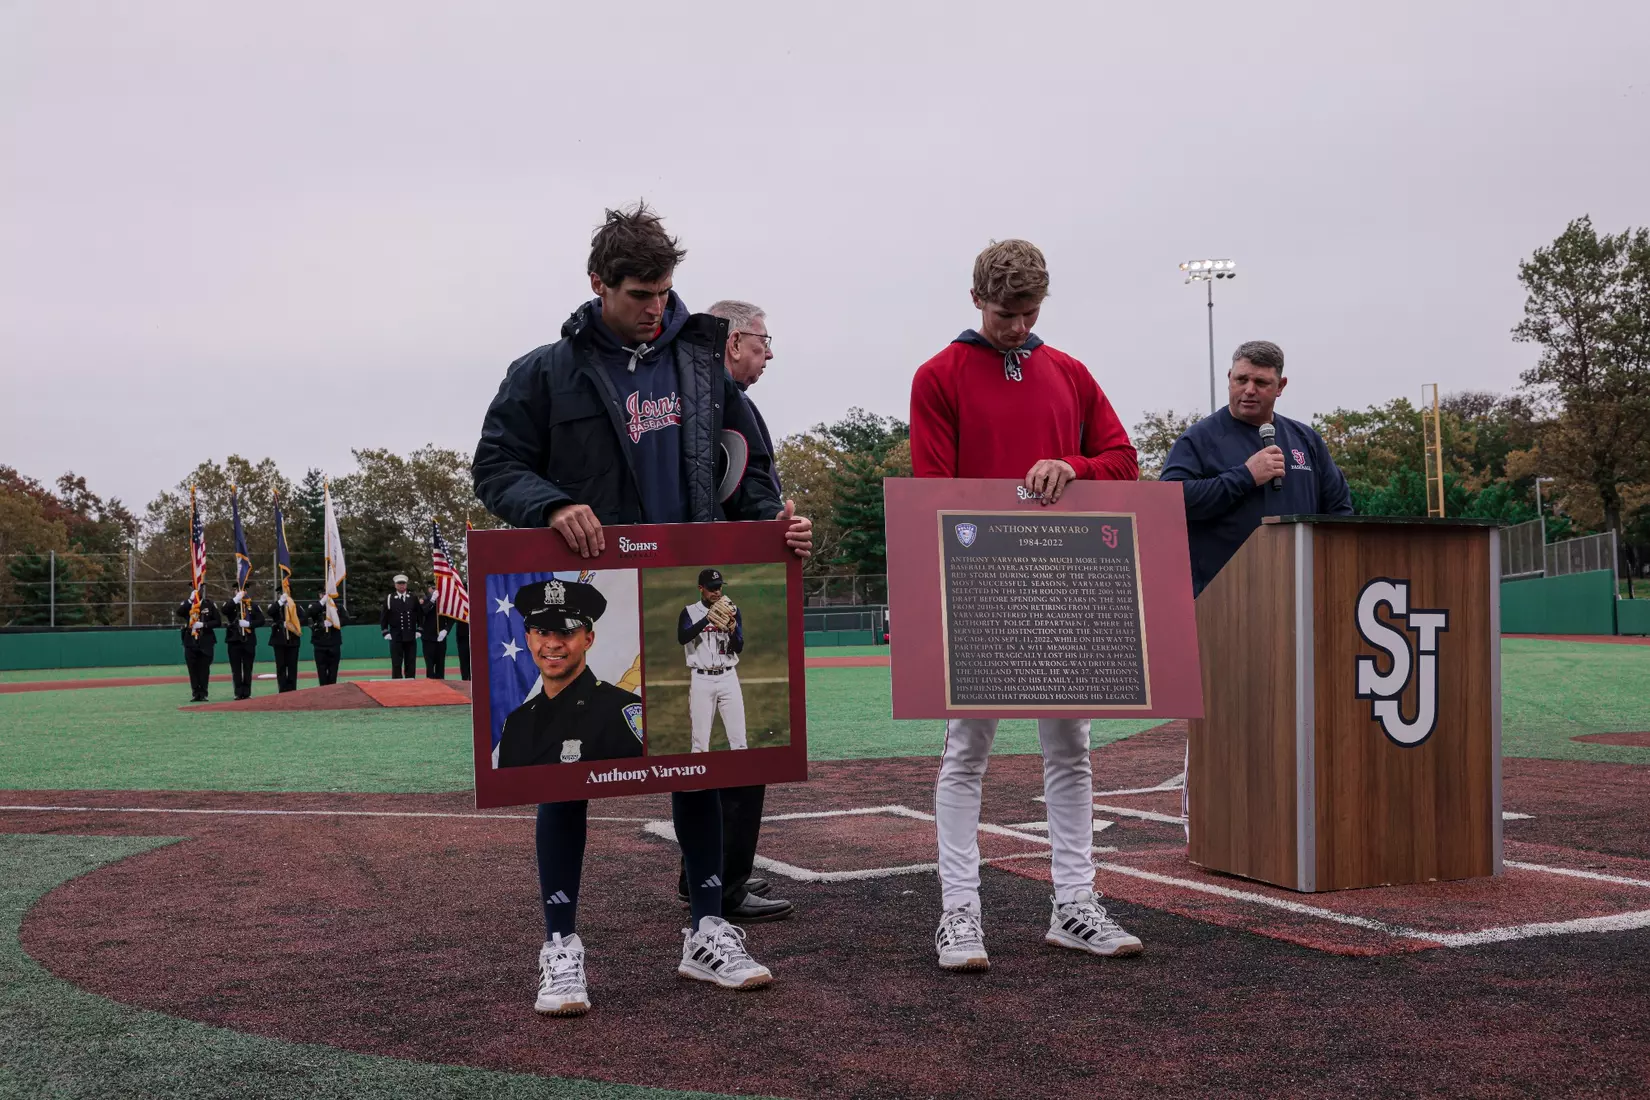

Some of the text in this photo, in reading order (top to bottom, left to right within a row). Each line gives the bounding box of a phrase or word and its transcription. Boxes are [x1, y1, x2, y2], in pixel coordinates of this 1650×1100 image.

[629, 416, 675, 433] BASEBALL
[988, 525, 1089, 534] ANTHONY VARVARO
[1018, 538, 1064, 547] 1984-2022
[586, 764, 707, 784] Anthony Varvaro
